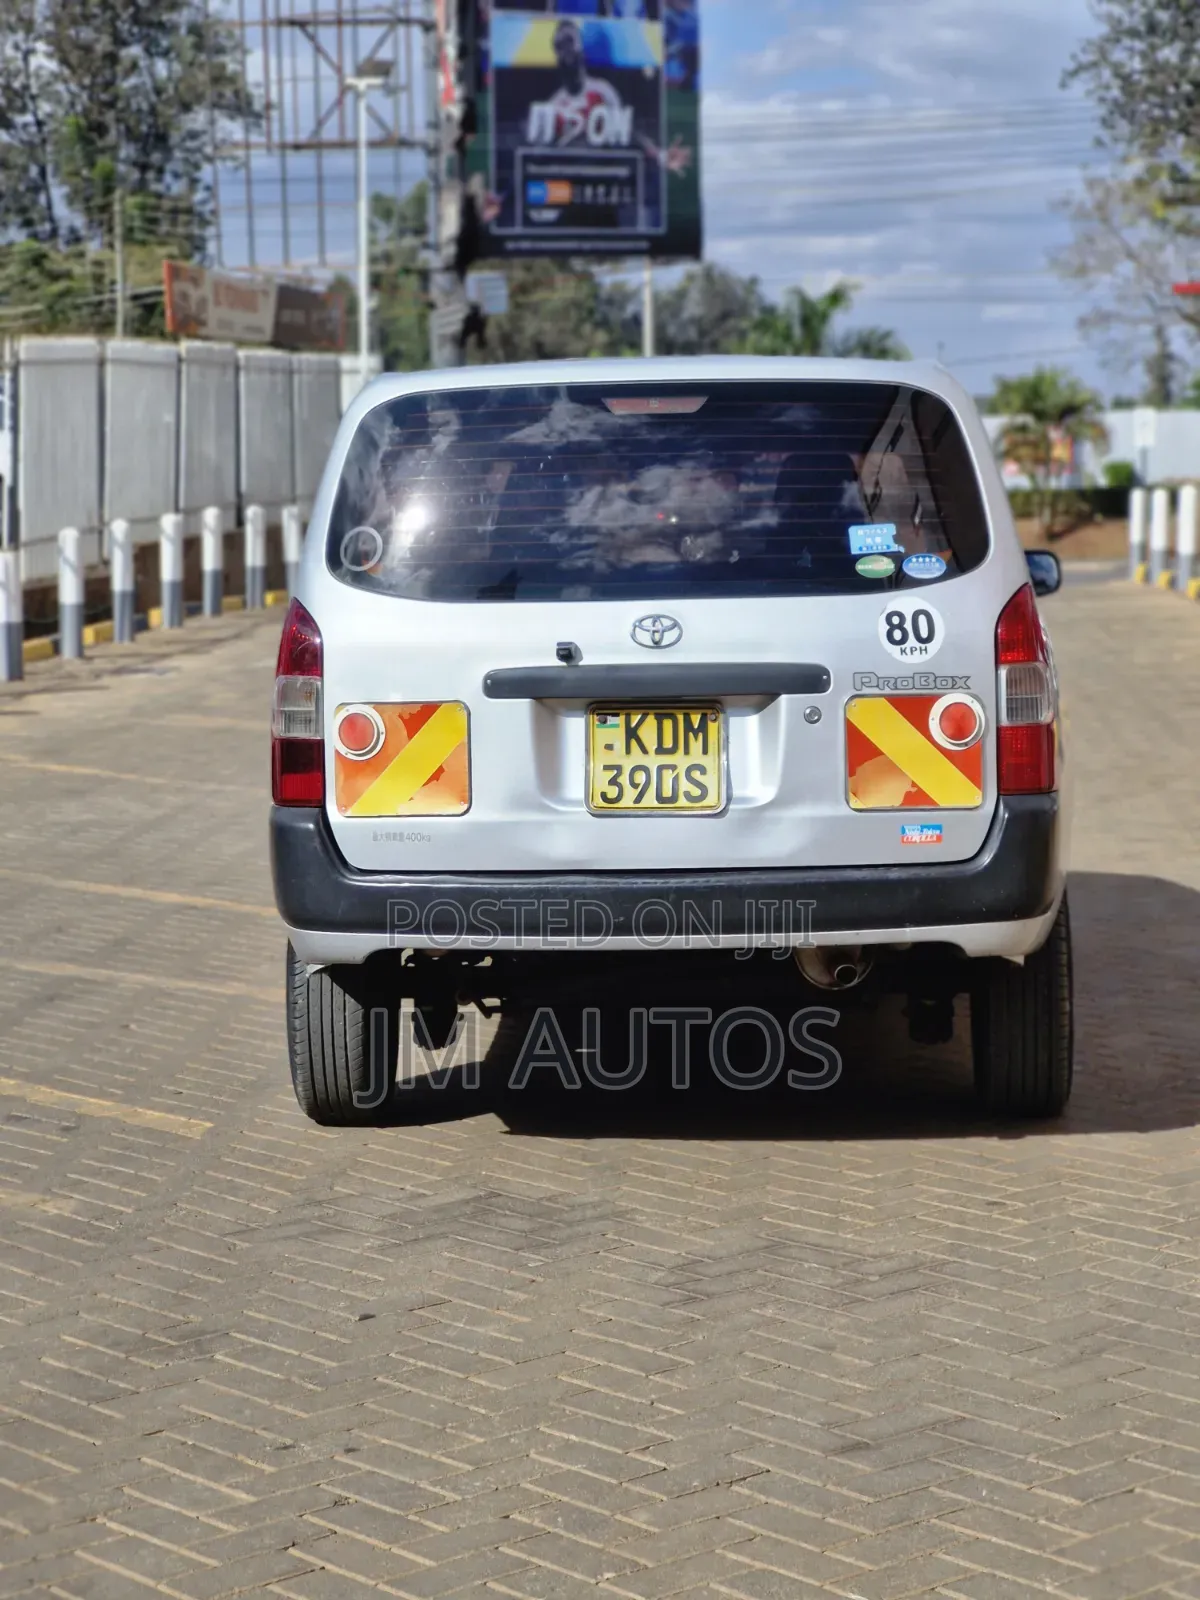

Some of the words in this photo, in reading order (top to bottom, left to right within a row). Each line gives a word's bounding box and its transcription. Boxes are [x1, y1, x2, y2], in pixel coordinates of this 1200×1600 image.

[885, 608, 936, 646] 80
[899, 646, 929, 656] KPH
[624, 712, 709, 755] KDM
[599, 763, 709, 804] 390S
